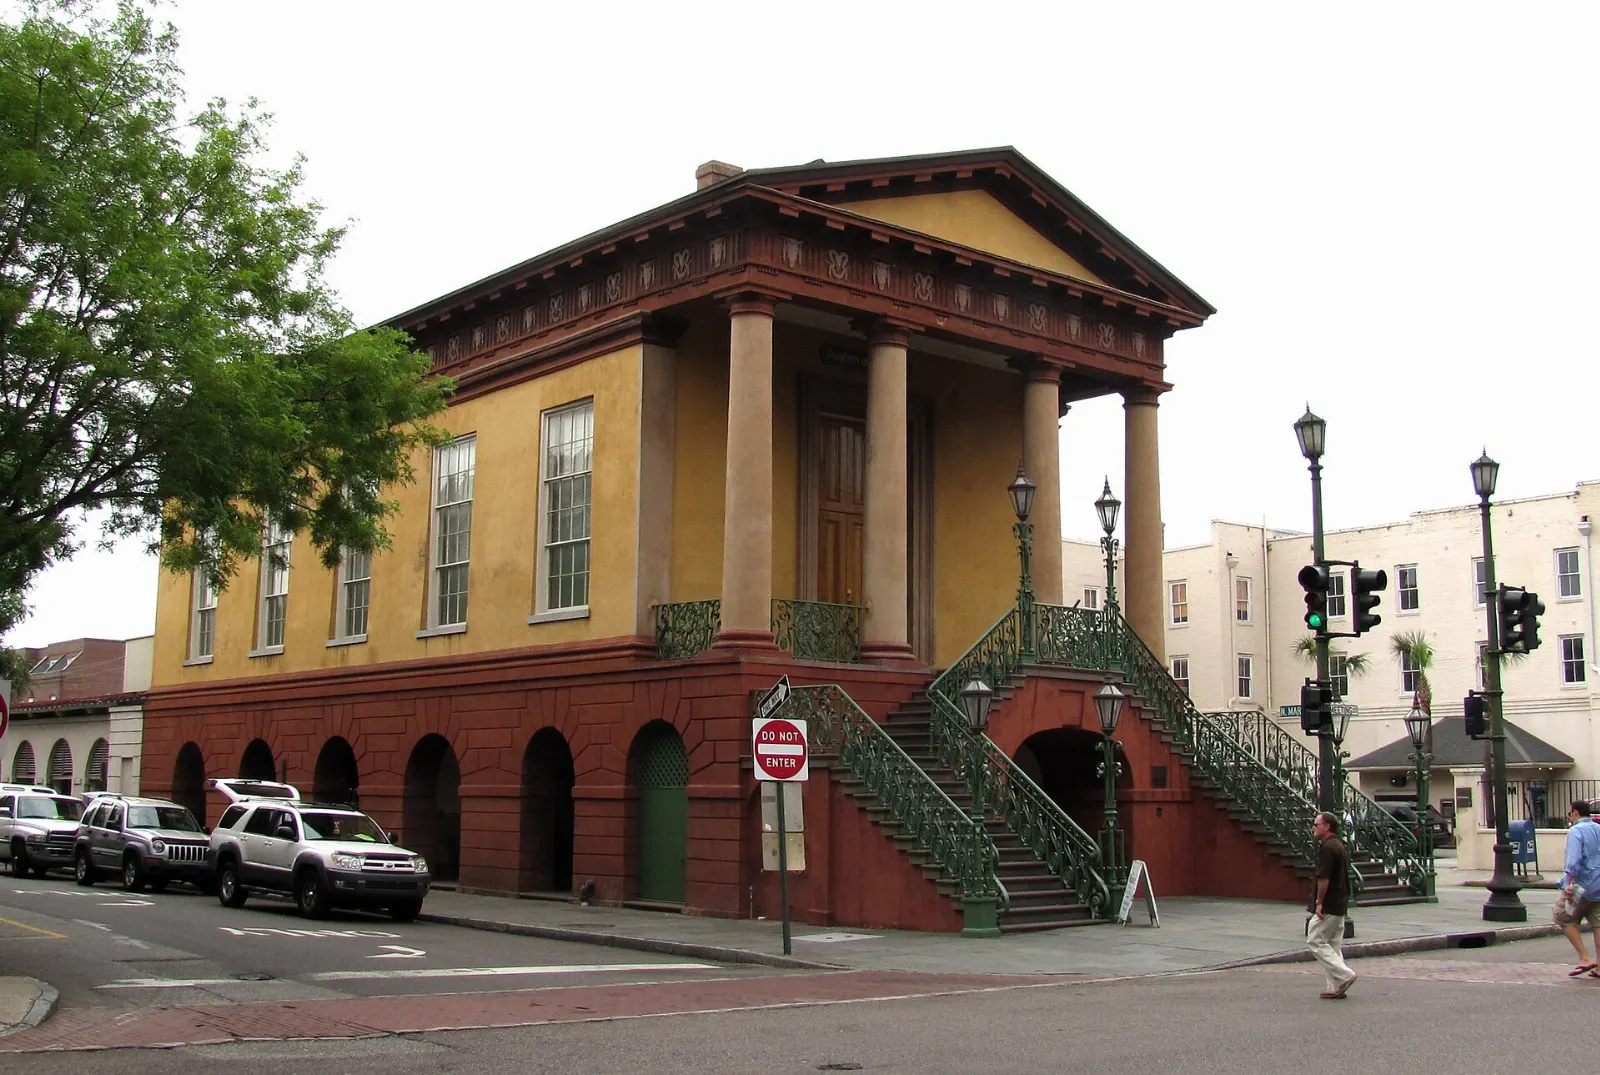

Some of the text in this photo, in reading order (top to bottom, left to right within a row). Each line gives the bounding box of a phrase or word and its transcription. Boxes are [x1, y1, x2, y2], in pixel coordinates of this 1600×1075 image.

[763, 691, 780, 715] ONE WAY
[1288, 706, 1301, 716] MAR
[762, 731, 798, 741] DO NOT
[766, 757, 796, 768] ENTER
